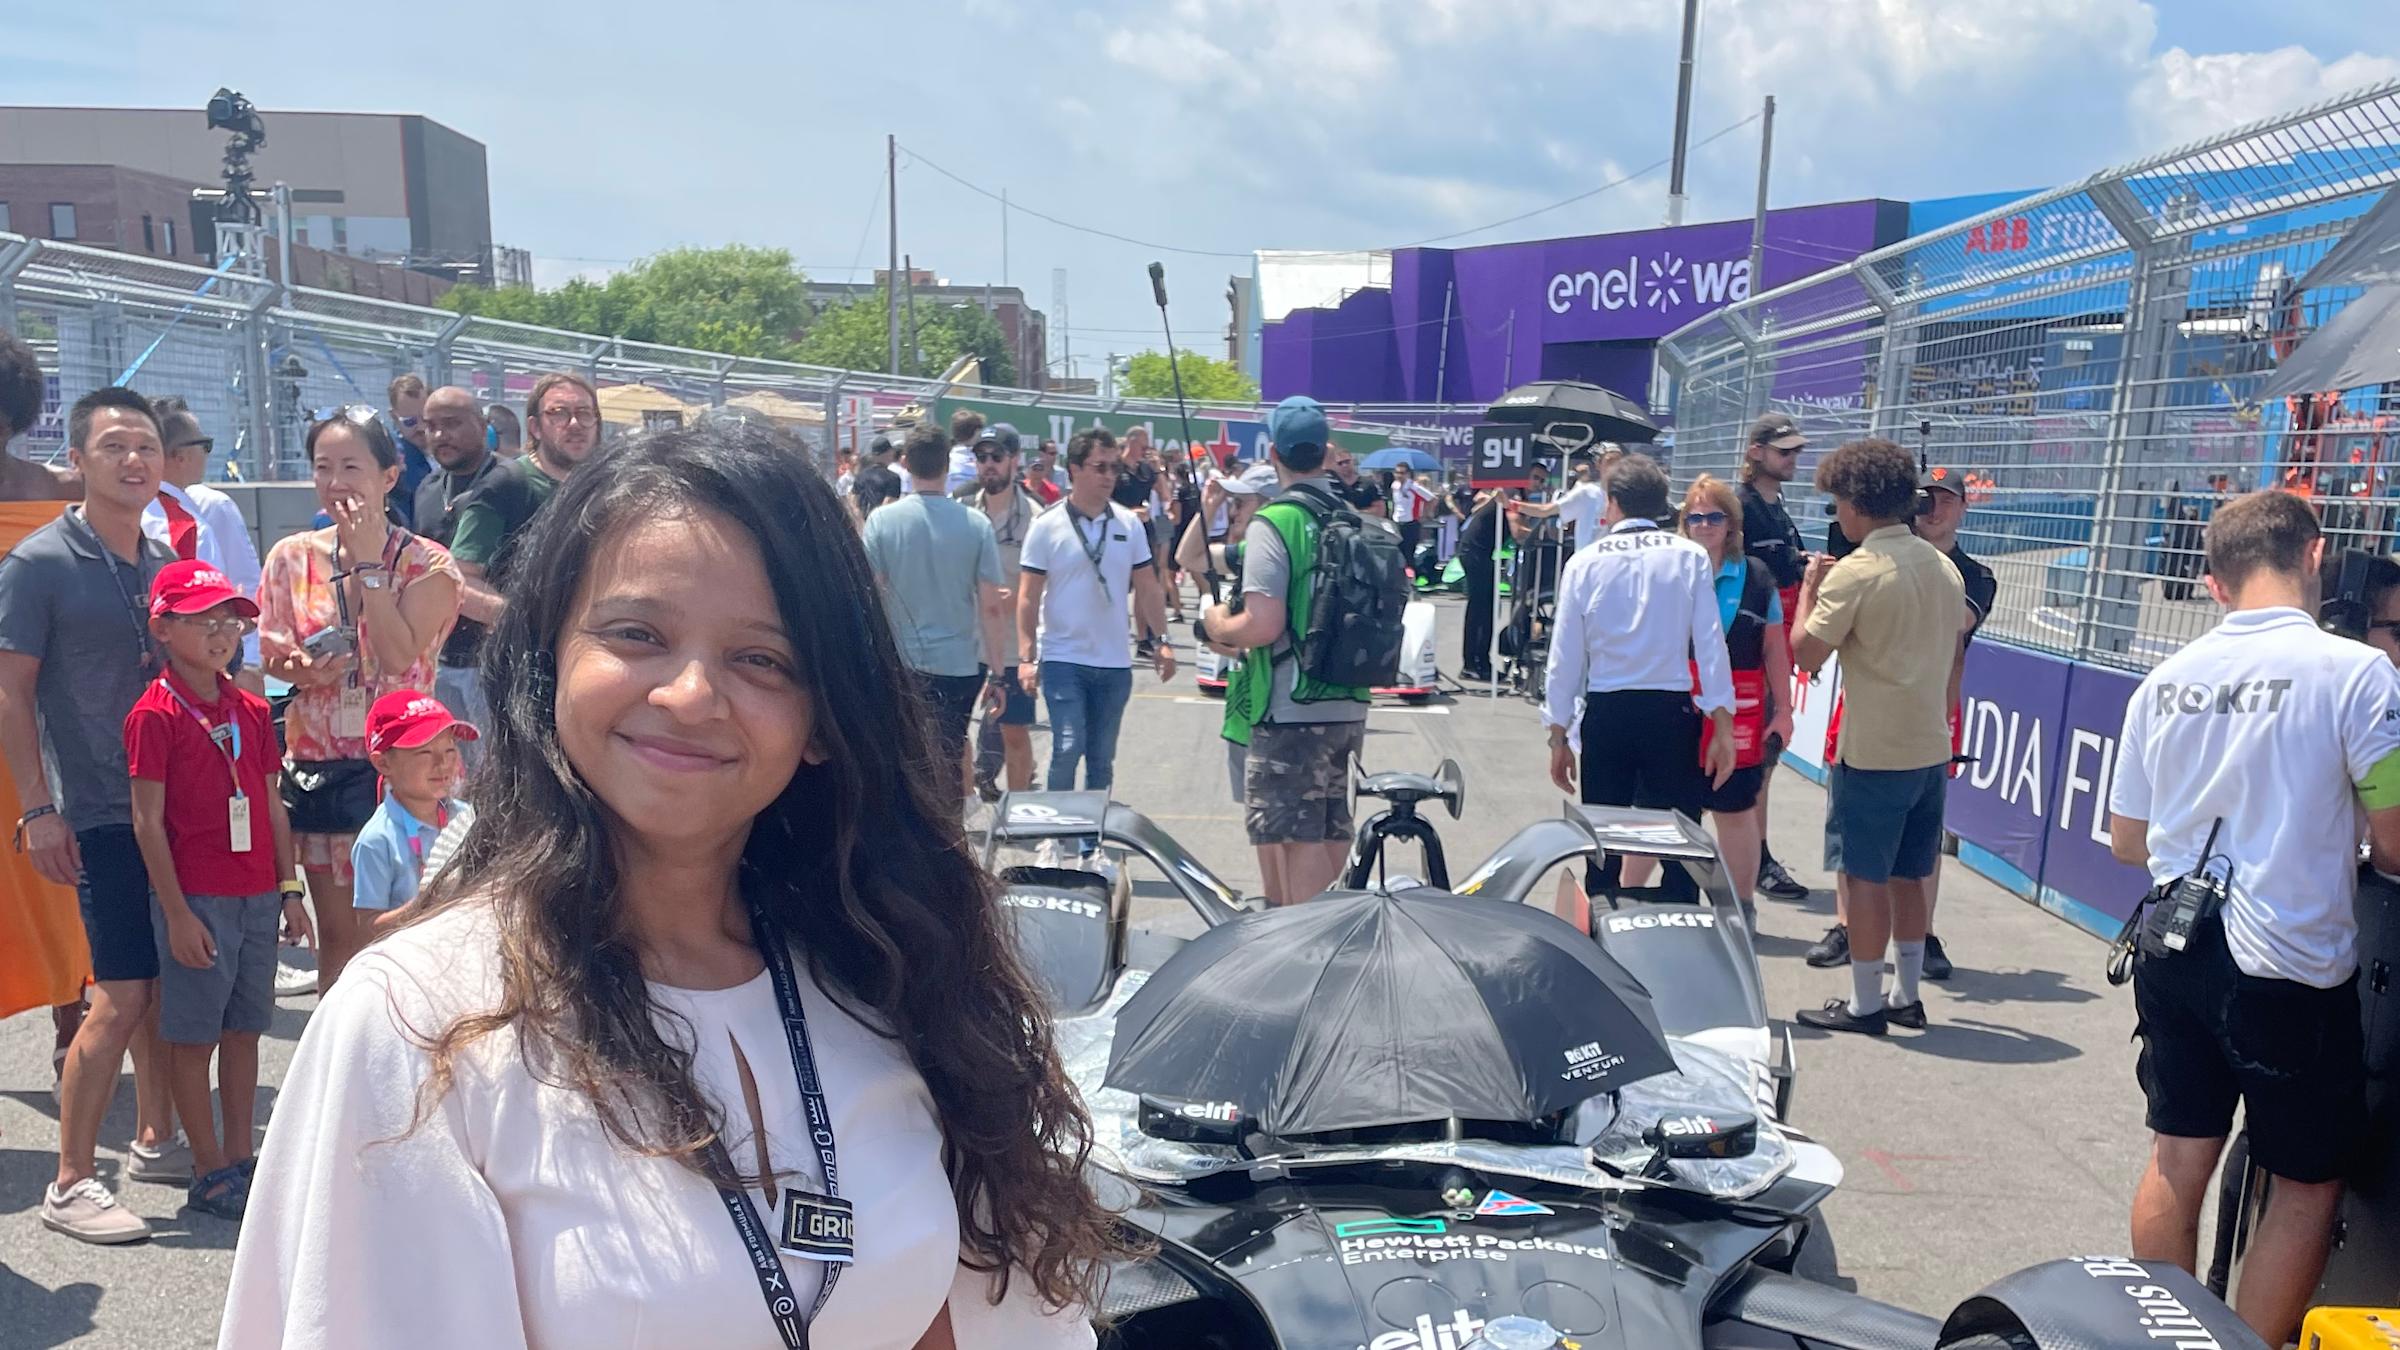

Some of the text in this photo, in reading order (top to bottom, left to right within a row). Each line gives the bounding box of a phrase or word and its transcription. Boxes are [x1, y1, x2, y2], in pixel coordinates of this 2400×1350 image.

[1965, 217, 2029, 254] ABB
[1548, 256, 1638, 313] enel
[1482, 437, 1522, 469] 94
[2155, 679, 2293, 717] ROKiT
[1561, 1055, 1625, 1081] VENTURI
[1340, 1234, 1609, 1261] Hewlett Packard
[1342, 1247, 1508, 1266] Enterprise
